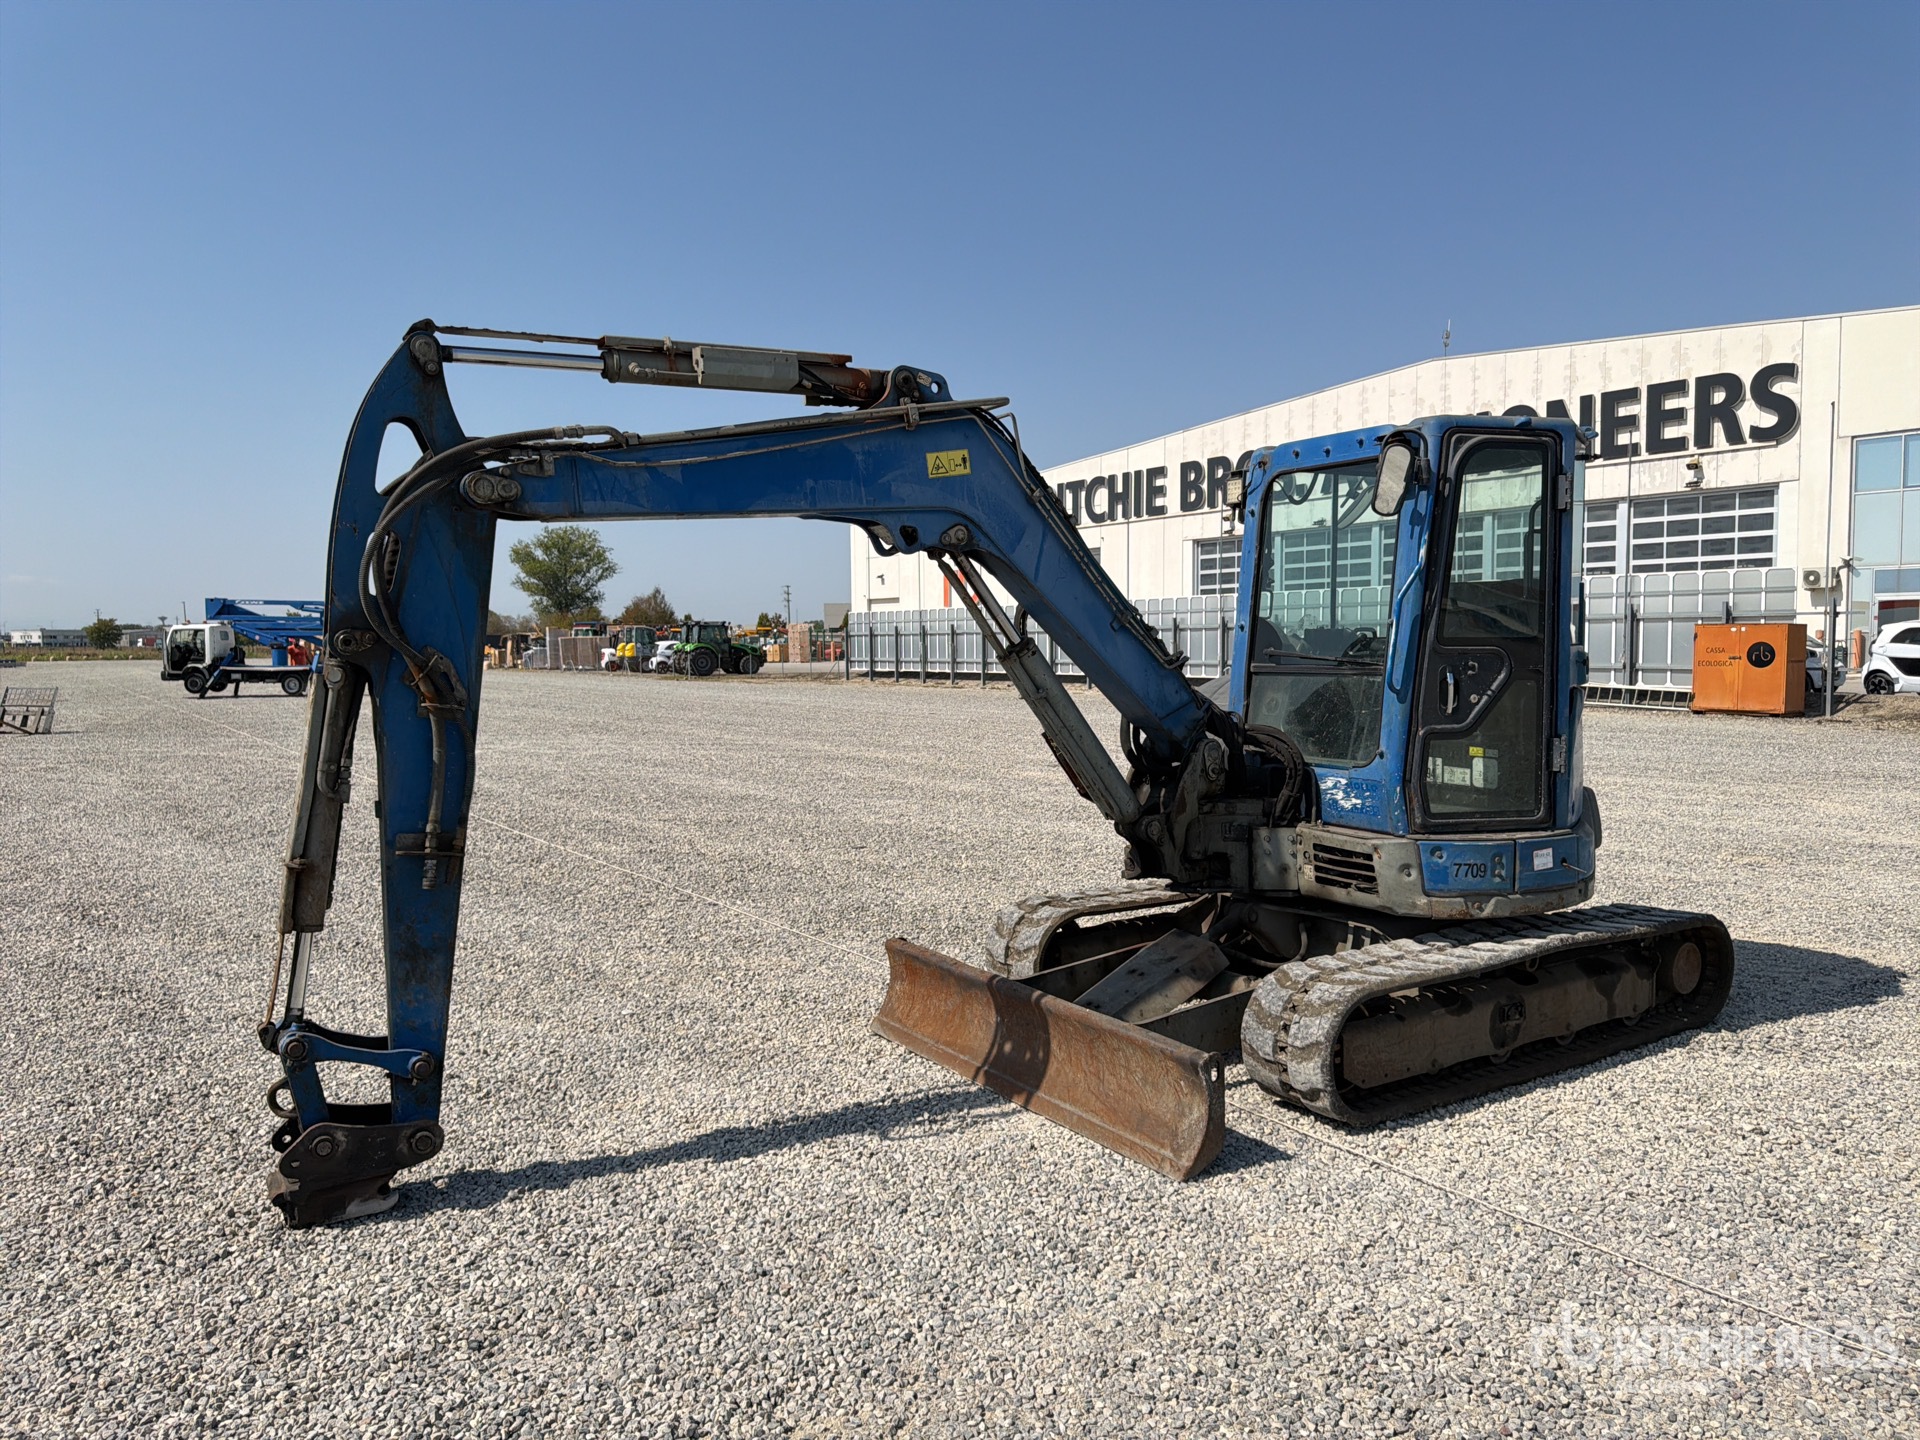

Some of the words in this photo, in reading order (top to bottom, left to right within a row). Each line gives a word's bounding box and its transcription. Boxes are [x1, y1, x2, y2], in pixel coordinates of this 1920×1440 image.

[1053, 464, 1167, 526] ITCHIE
[1705, 646, 1726, 654] CASSA
[1453, 862, 1487, 879] 7709
